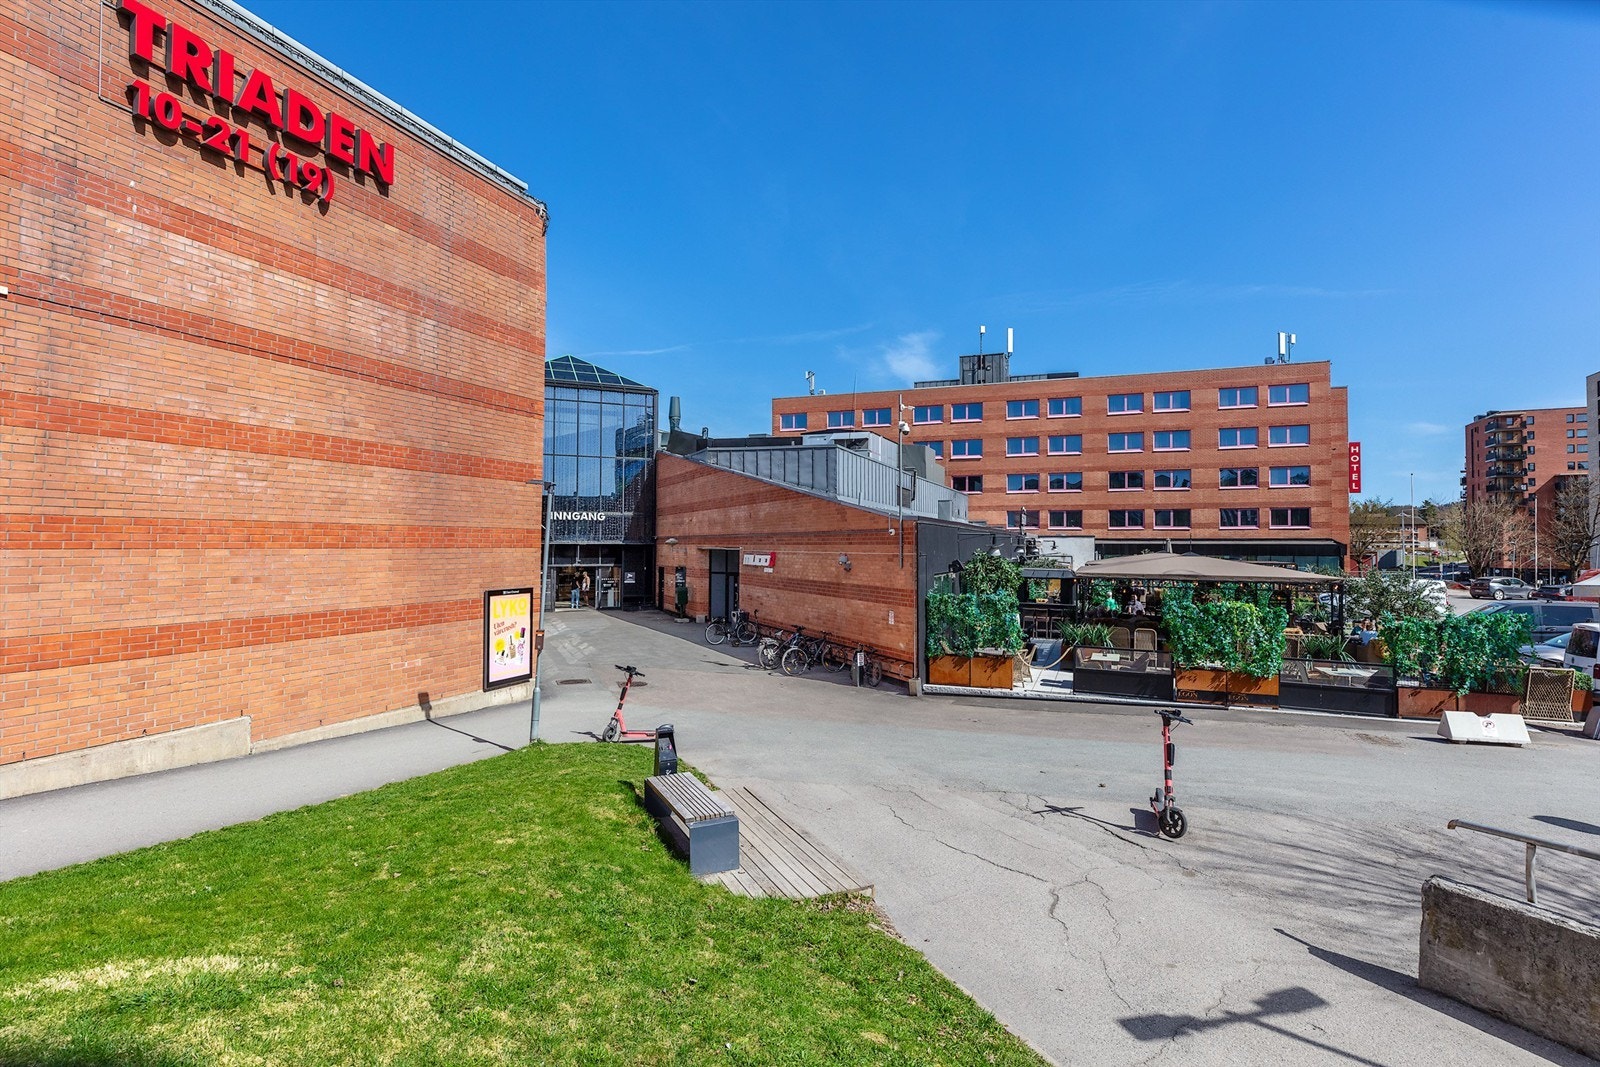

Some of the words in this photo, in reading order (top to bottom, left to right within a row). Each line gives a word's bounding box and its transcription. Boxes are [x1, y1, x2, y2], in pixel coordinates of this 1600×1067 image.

[117, 0, 395, 186] TRIADEN
[126, 79, 250, 164] 10-21
[263, 142, 335, 202] (19)
[1350, 446, 1360, 490] HOTEL
[550, 511, 606, 521] INNGANG
